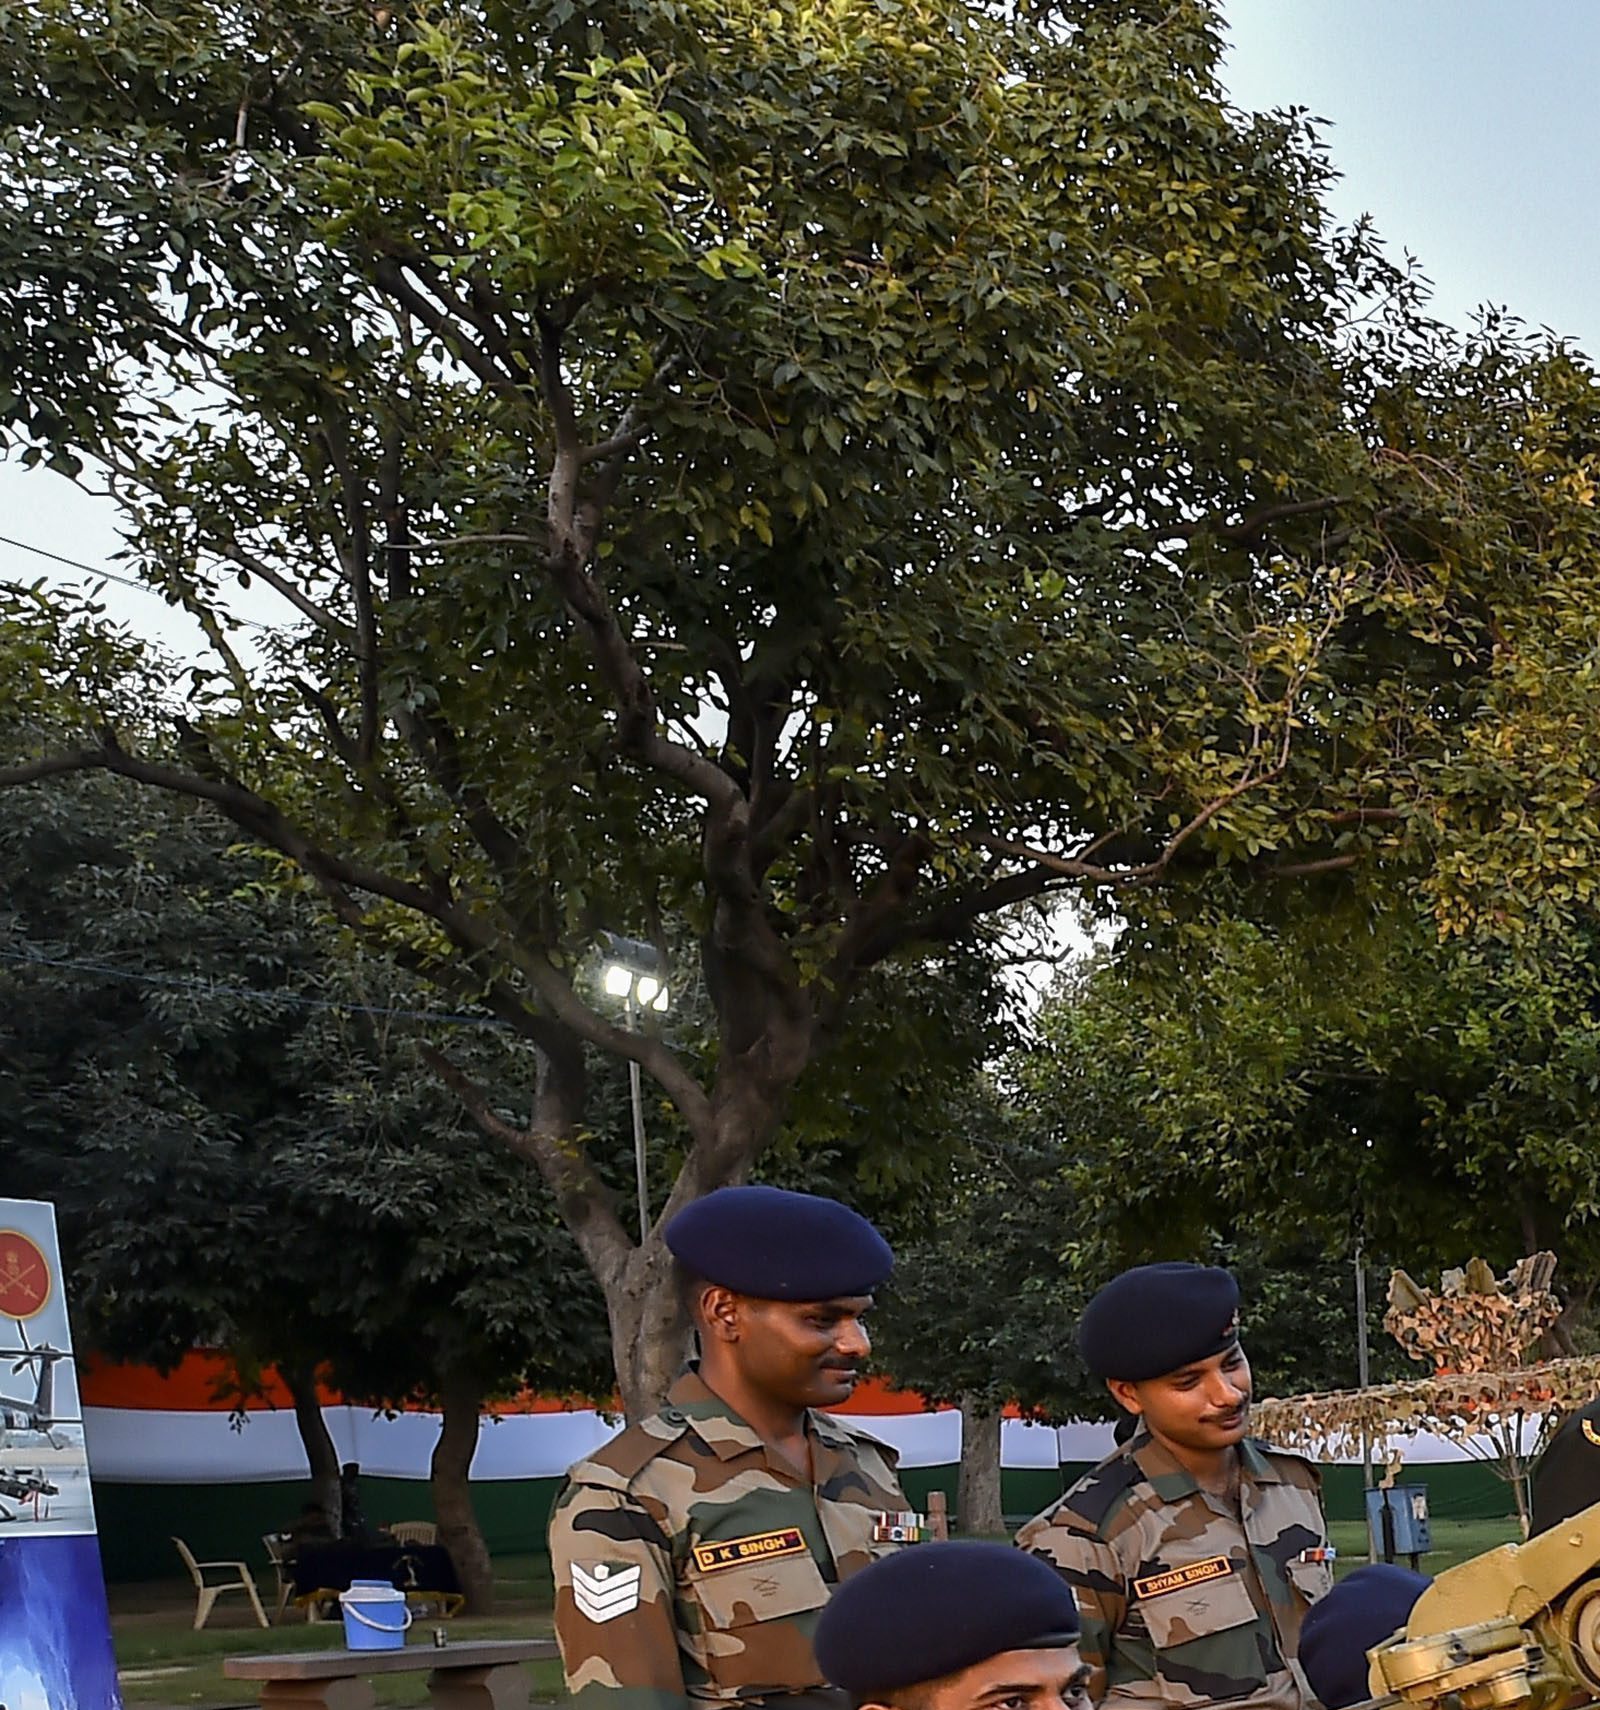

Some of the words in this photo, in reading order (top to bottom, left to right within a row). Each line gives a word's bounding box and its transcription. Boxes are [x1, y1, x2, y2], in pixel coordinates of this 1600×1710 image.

[702, 1552, 714, 1564] D
[720, 1547, 732, 1559] K
[739, 1537, 786, 1556] SINGH
[1146, 1573, 1185, 1592] SHYAM
[1185, 1562, 1219, 1580] SINGH
